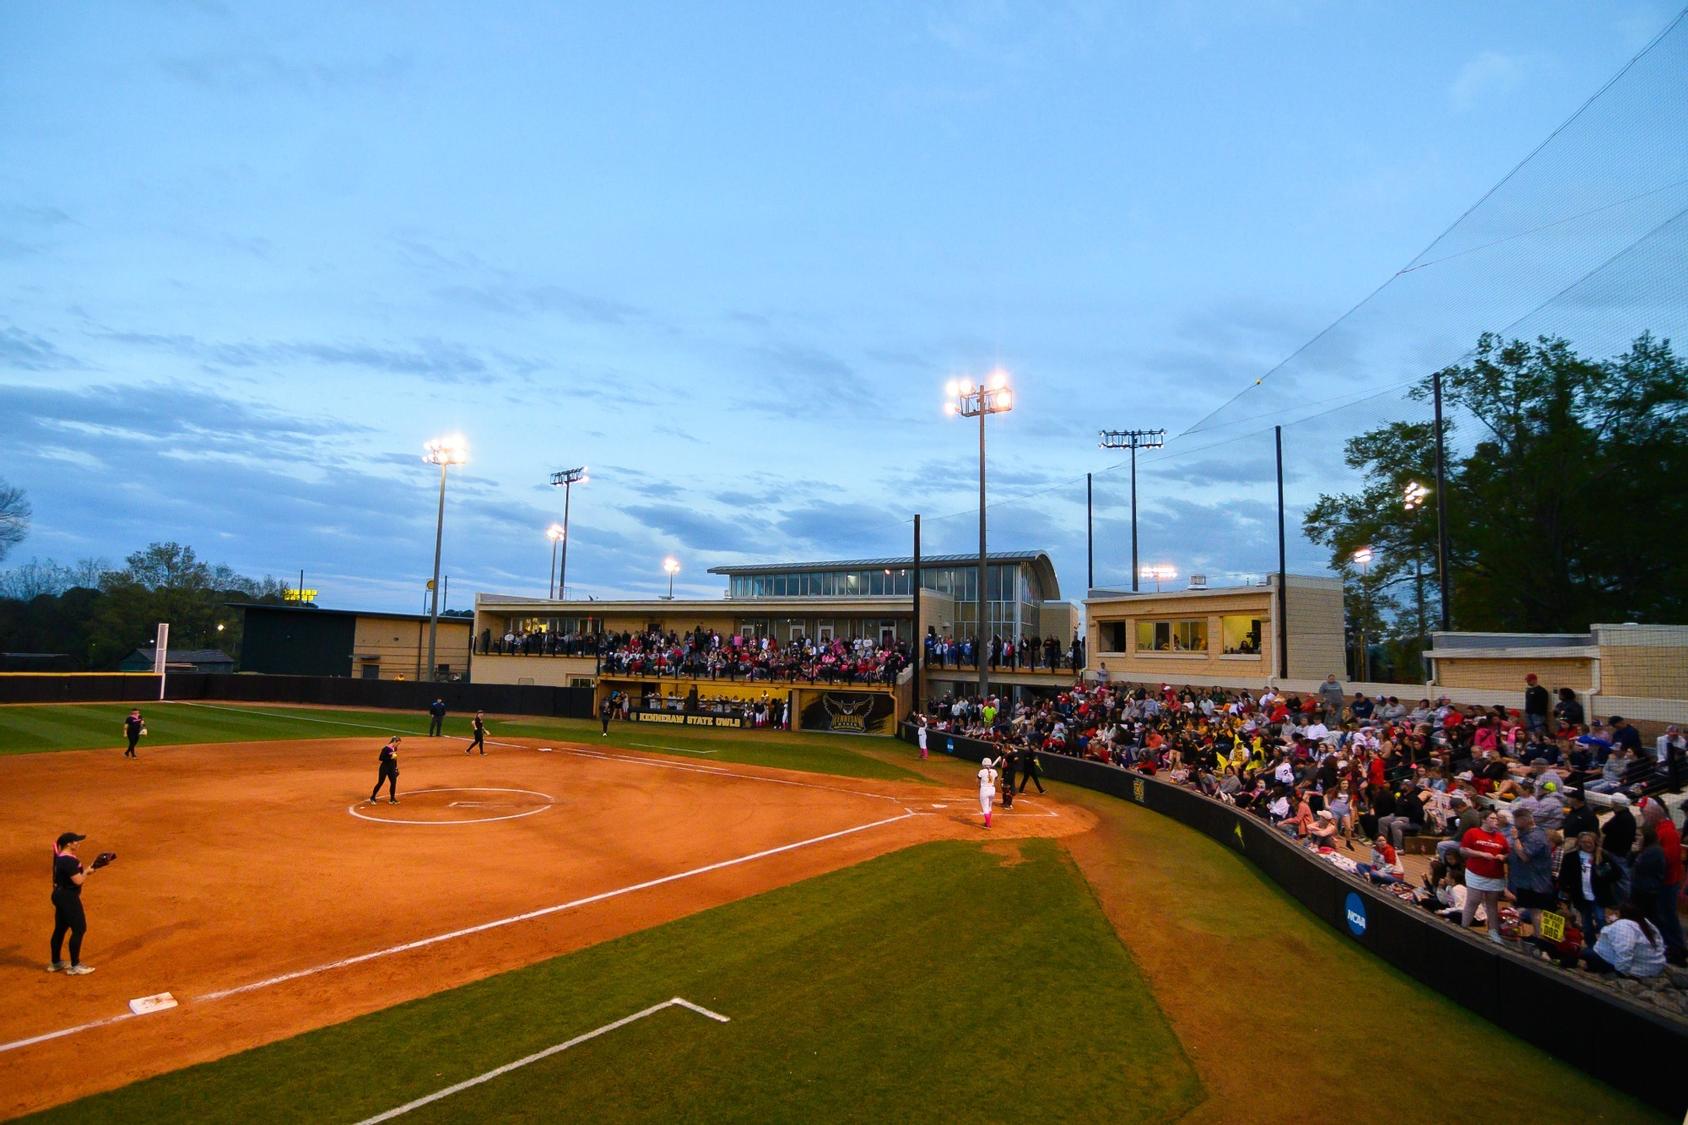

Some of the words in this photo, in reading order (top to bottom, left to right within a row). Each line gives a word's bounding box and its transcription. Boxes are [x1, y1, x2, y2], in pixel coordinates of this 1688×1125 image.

[640, 712, 685, 724] KENNESAW
[687, 715, 713, 726] STATE
[716, 718, 740, 728] OWLS
